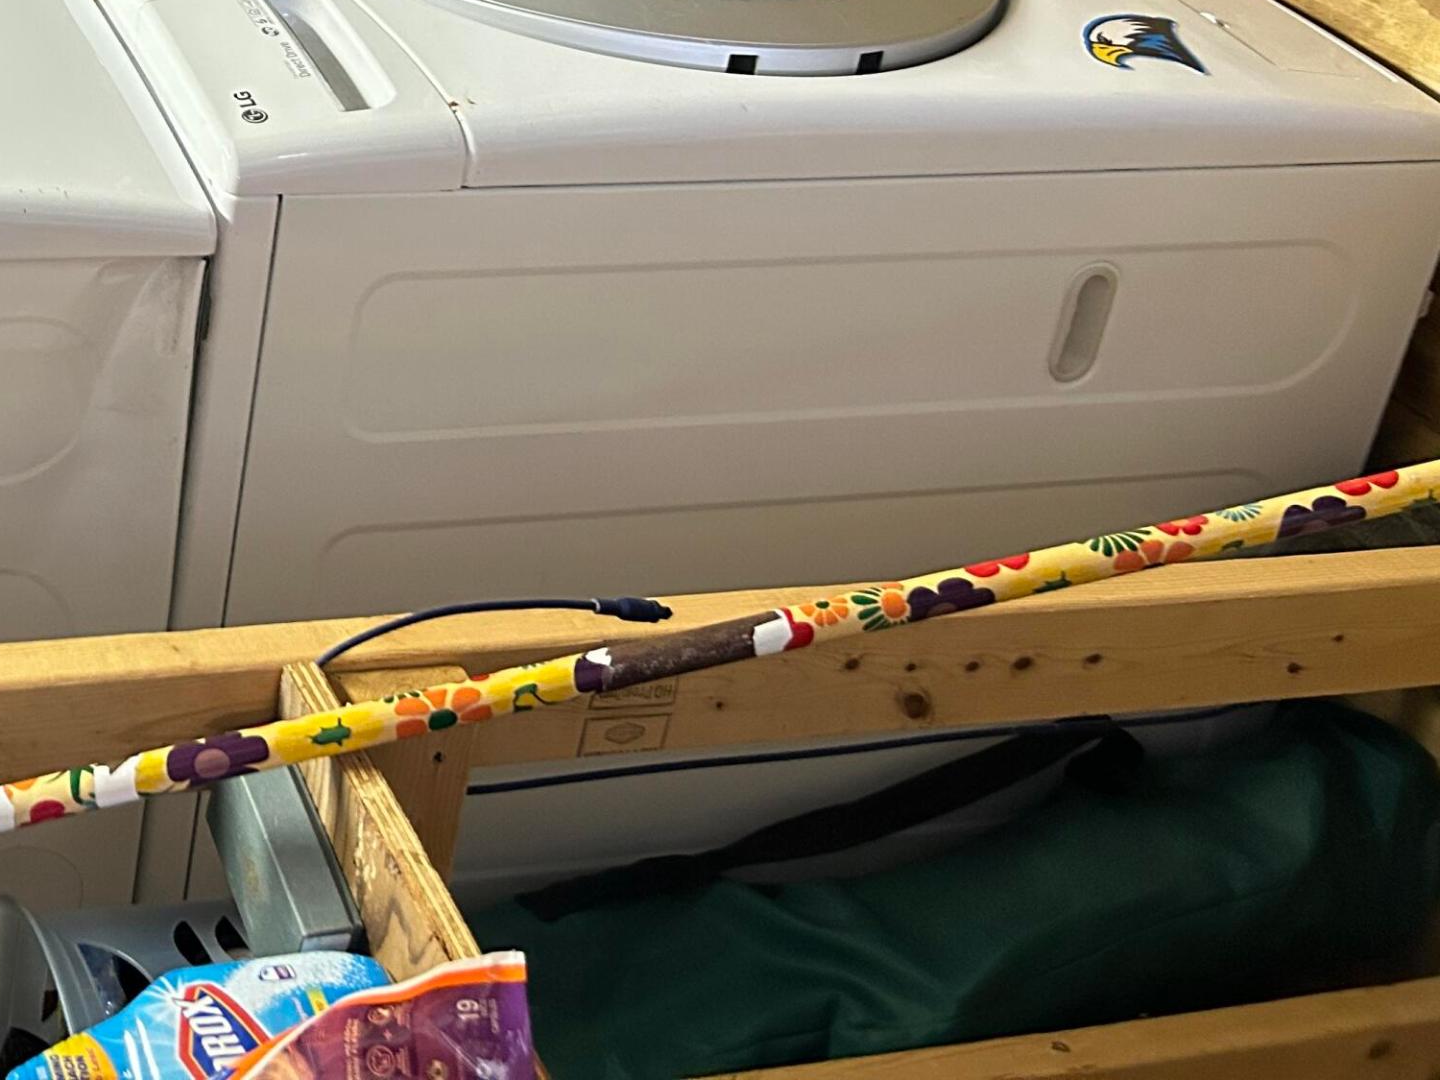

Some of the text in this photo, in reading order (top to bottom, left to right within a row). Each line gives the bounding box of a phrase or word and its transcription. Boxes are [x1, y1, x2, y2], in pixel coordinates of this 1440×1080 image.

[280, 42, 297, 58] Drive
[290, 58, 311, 78] Direct
[233, 91, 256, 108] LG
[456, 999, 480, 1020] 19
